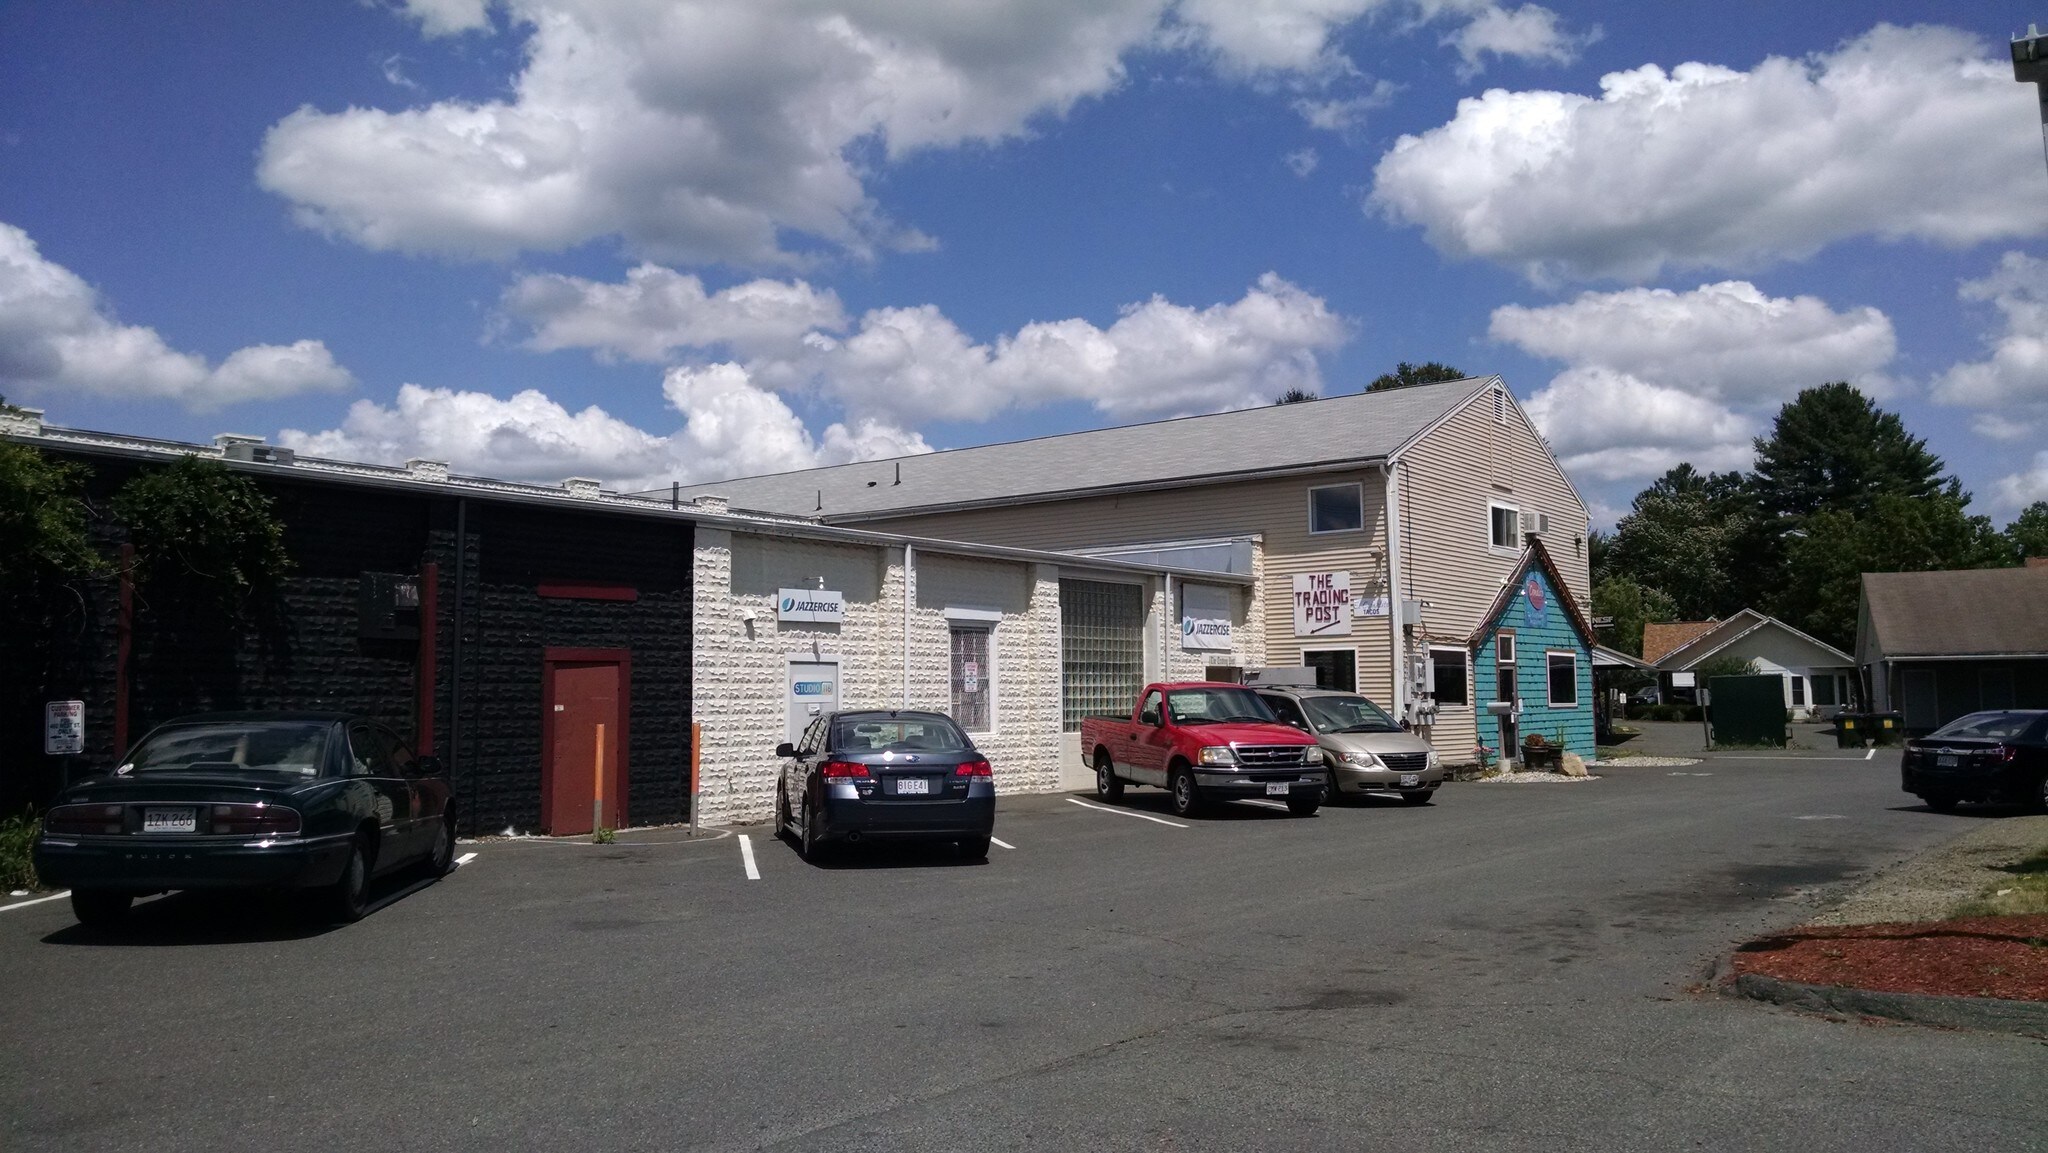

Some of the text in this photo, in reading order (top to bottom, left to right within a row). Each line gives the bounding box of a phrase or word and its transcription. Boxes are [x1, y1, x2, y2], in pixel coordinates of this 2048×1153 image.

[1309, 574, 1333, 589] THE
[1295, 589, 1348, 607] TRADING
[796, 601, 839, 612] JAZZERCISE
[1306, 606, 1340, 623] POST
[1196, 623, 1230, 635] JAZZERCISE
[795, 683, 821, 693] STUDIO
[51, 704, 81, 712] CUSTOMER
